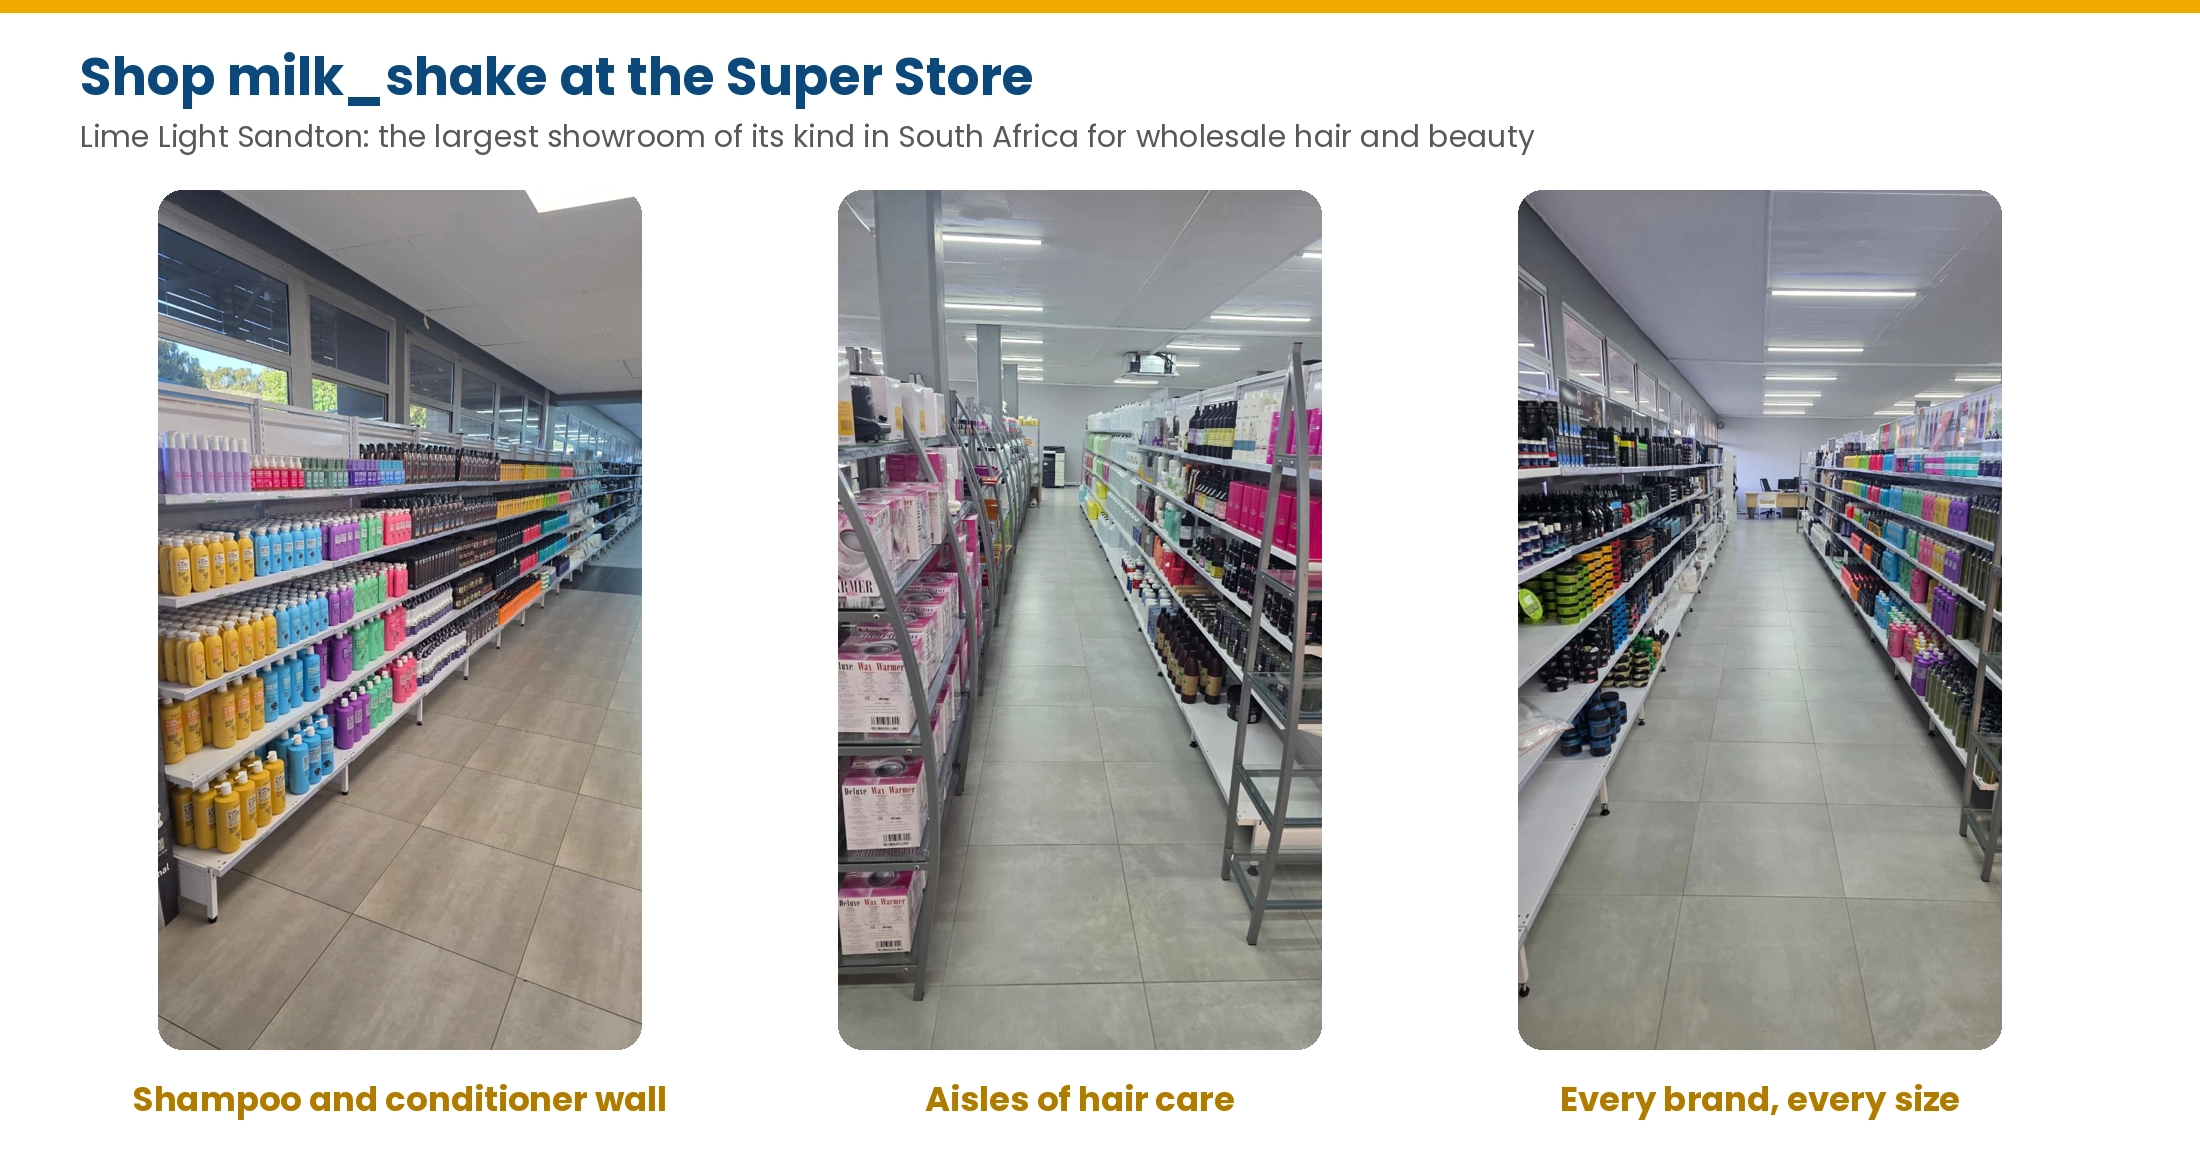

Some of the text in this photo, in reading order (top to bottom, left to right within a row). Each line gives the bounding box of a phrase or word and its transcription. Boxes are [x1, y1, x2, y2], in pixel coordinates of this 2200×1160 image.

[857, 661, 872, 671] Wax
[876, 662, 904, 671] Warmer
[844, 786, 915, 795] Deluxe Wax Warmer
[864, 898, 877, 906] Wax
